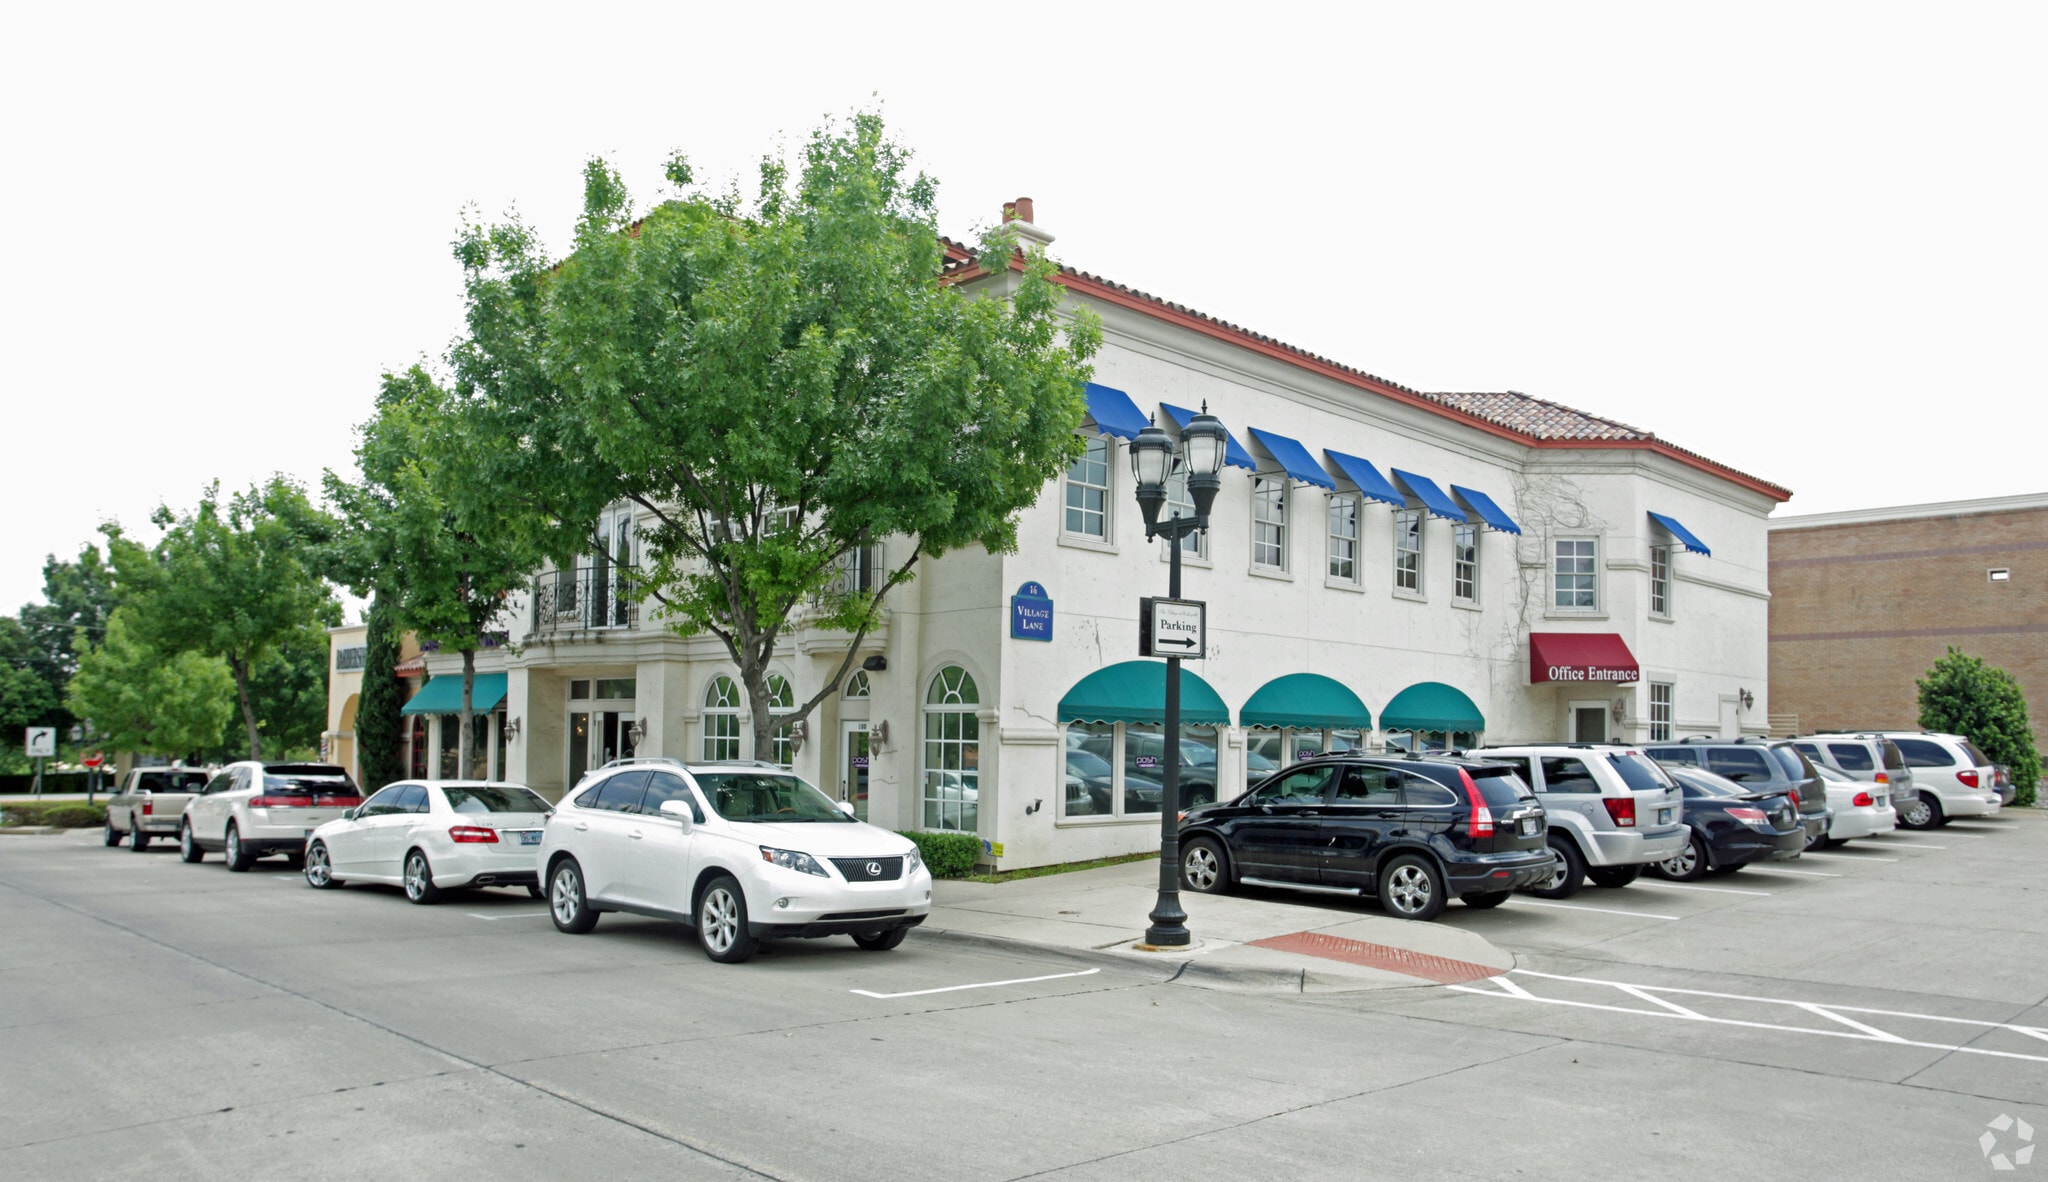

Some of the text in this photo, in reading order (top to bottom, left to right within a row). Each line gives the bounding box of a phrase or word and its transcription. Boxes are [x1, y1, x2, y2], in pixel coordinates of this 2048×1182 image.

[1017, 605, 1050, 619] VILLAGE
[1022, 618, 1044, 631] LANE
[1160, 619, 1197, 634] Parking
[1549, 666, 1638, 681] Office Entrance
